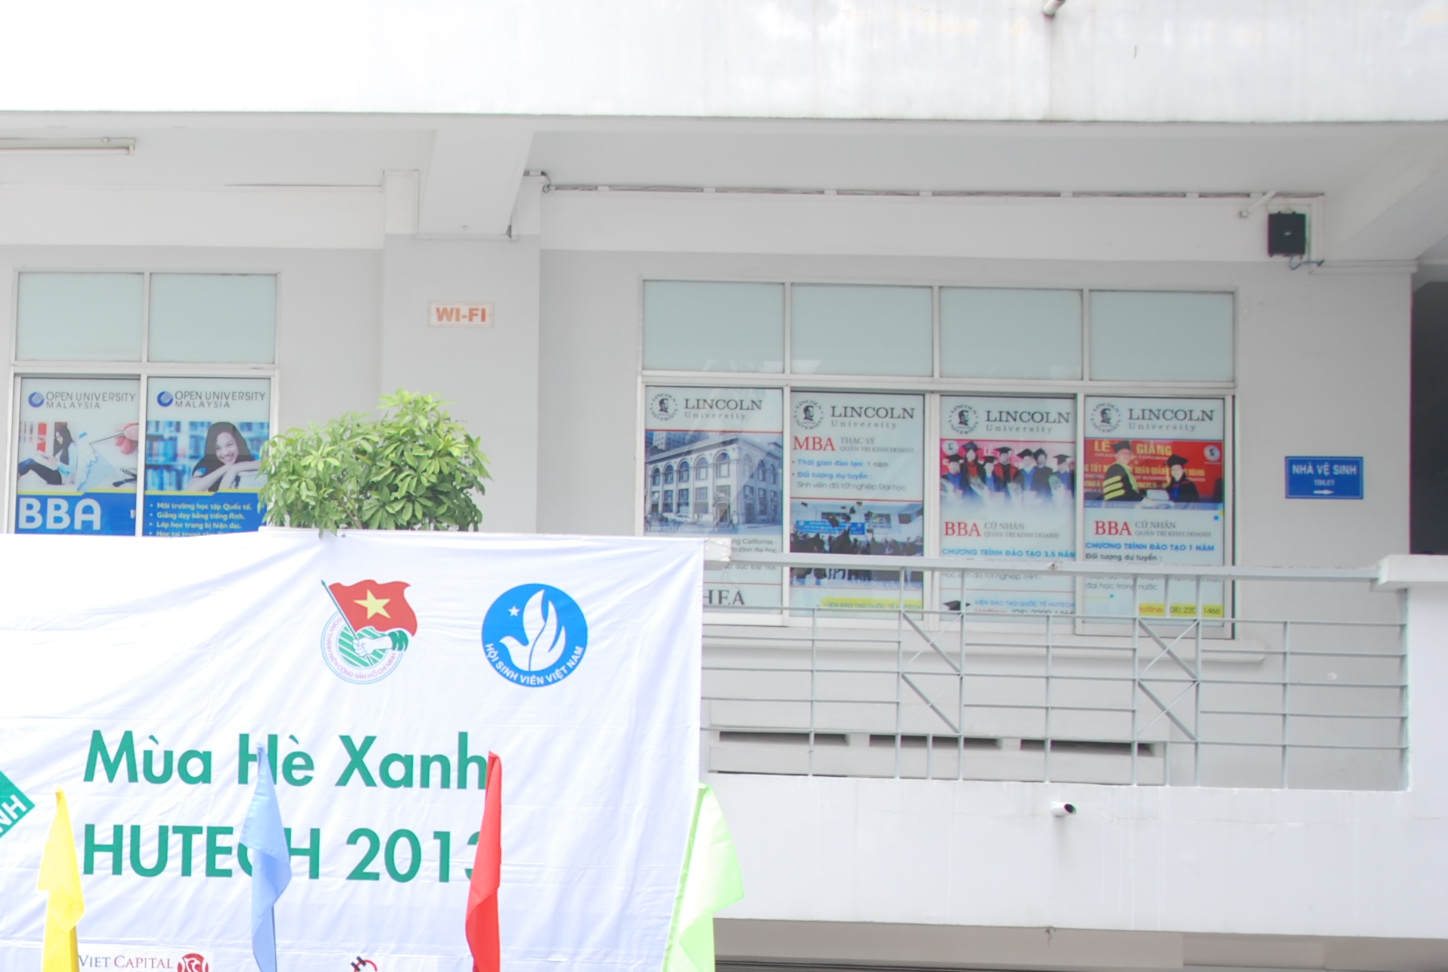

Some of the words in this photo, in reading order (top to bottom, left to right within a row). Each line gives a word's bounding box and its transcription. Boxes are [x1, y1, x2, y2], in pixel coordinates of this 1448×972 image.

[435, 307, 487, 323] WI-FI
[46, 392, 74, 402] OPEN
[76, 392, 136, 402] UNIVERSITY
[174, 390, 204, 400] OPEN
[205, 392, 266, 402] UNIVERSITY
[46, 402, 101, 410] MALAYSIA
[174, 400, 230, 409] MALAYSIA
[684, 398, 763, 412] LINCOLN
[684, 411, 747, 421] University
[830, 406, 916, 420] LINCOLN
[985, 410, 1072, 424] LINCOLN
[1128, 408, 1215, 422] LINCOLN
[830, 420, 897, 430] University
[986, 425, 1053, 434] University
[1128, 423, 1196, 433] University
[792, 436, 836, 452] MBA
[1292, 462, 1314, 475] NHÀ
[1316, 461, 1331, 477] VỆ
[1333, 464, 1358, 476] SINH
[18, 498, 103, 531] BBA
[944, 521, 982, 537] BBA
[1095, 520, 1132, 536] BBA
[1124, 542, 1148, 550] TRÌNH
[1150, 542, 1168, 551] ĐÀO
[1196, 544, 1215, 552] NĂM
[485, 643, 500, 662] HỘI
[495, 660, 518, 680] SINH
[520, 675, 544, 685] VIÊN
[545, 666, 568, 683] VIỆT
[566, 646, 584, 668] NAM
[83, 729, 212, 785] Mùa
[238, 733, 315, 787] Hè
[335, 731, 488, 790] Xanh
[78, 955, 111, 968] VIET
[113, 955, 174, 969] CAPITAL
